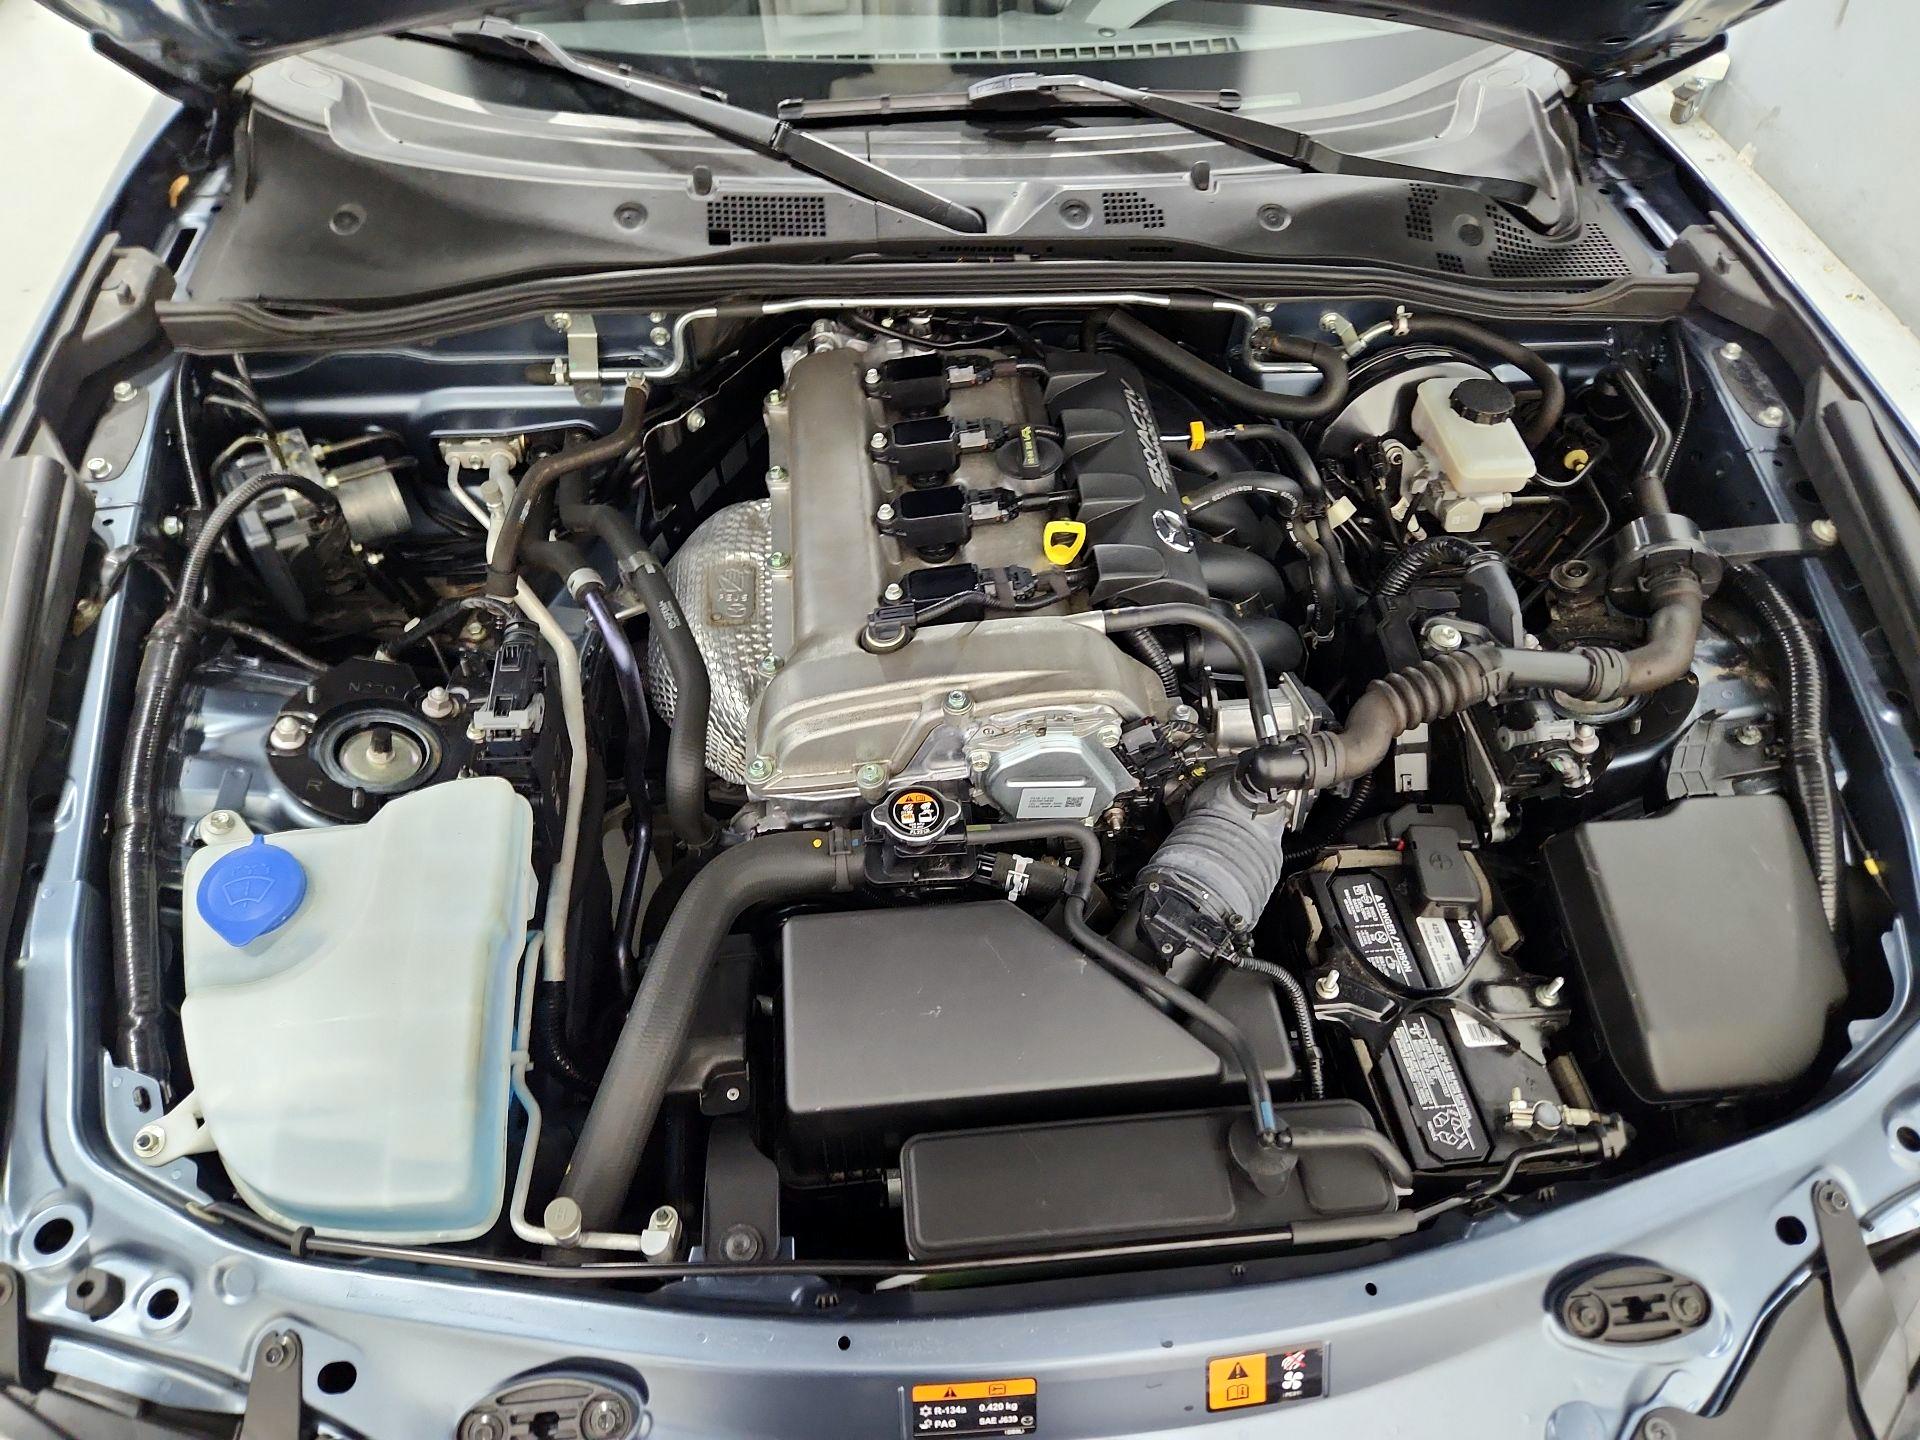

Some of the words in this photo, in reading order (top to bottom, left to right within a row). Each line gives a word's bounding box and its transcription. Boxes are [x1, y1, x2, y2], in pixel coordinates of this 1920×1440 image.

[1120, 378, 1168, 494] SKYACTIV
[1377, 902, 1397, 935] DANGER
[1393, 942, 1413, 973] POISON
[933, 1405, 967, 1416] R-134a
[1005, 1401, 1018, 1412] kg
[933, 1418, 957, 1429] PAG
[978, 1416, 998, 1426] SAE
